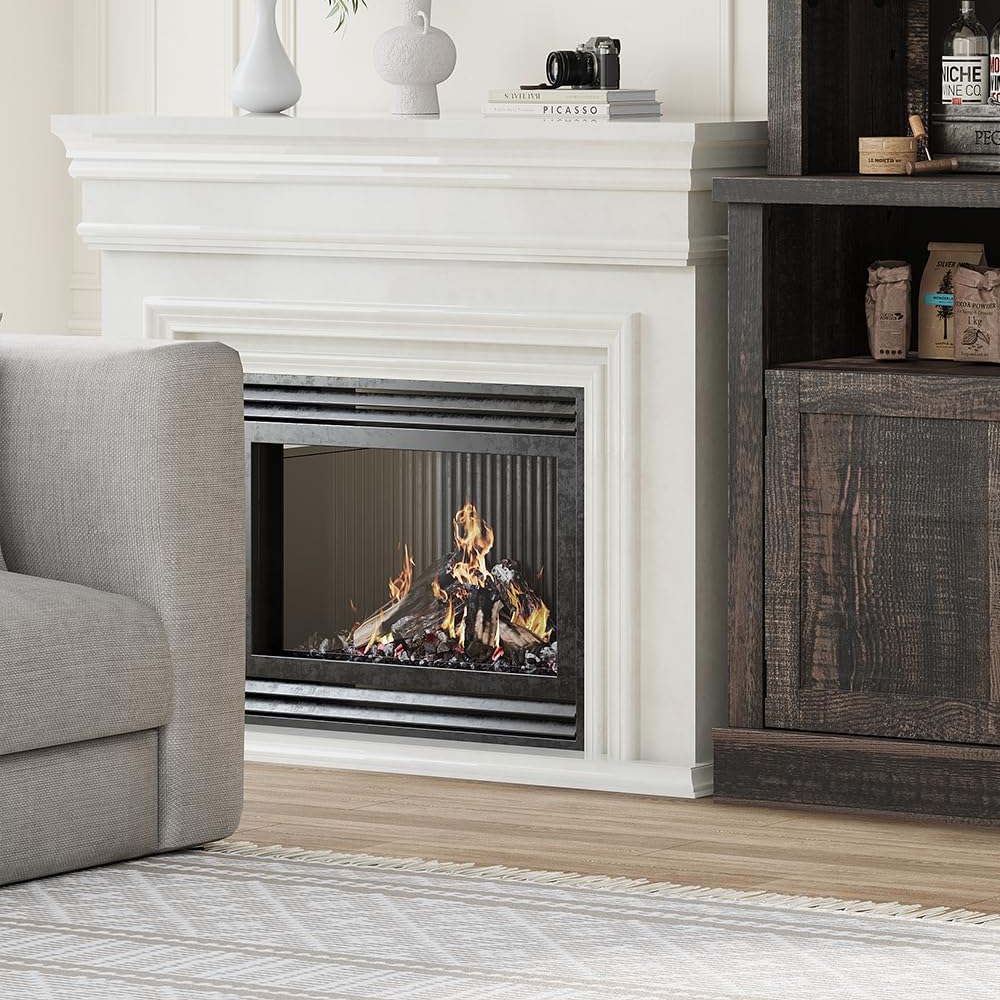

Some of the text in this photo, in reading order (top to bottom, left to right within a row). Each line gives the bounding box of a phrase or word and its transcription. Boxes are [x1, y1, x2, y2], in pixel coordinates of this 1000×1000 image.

[943, 66, 981, 82] NICHE
[543, 105, 598, 114] PICASSO
[973, 315, 983, 328] kg
